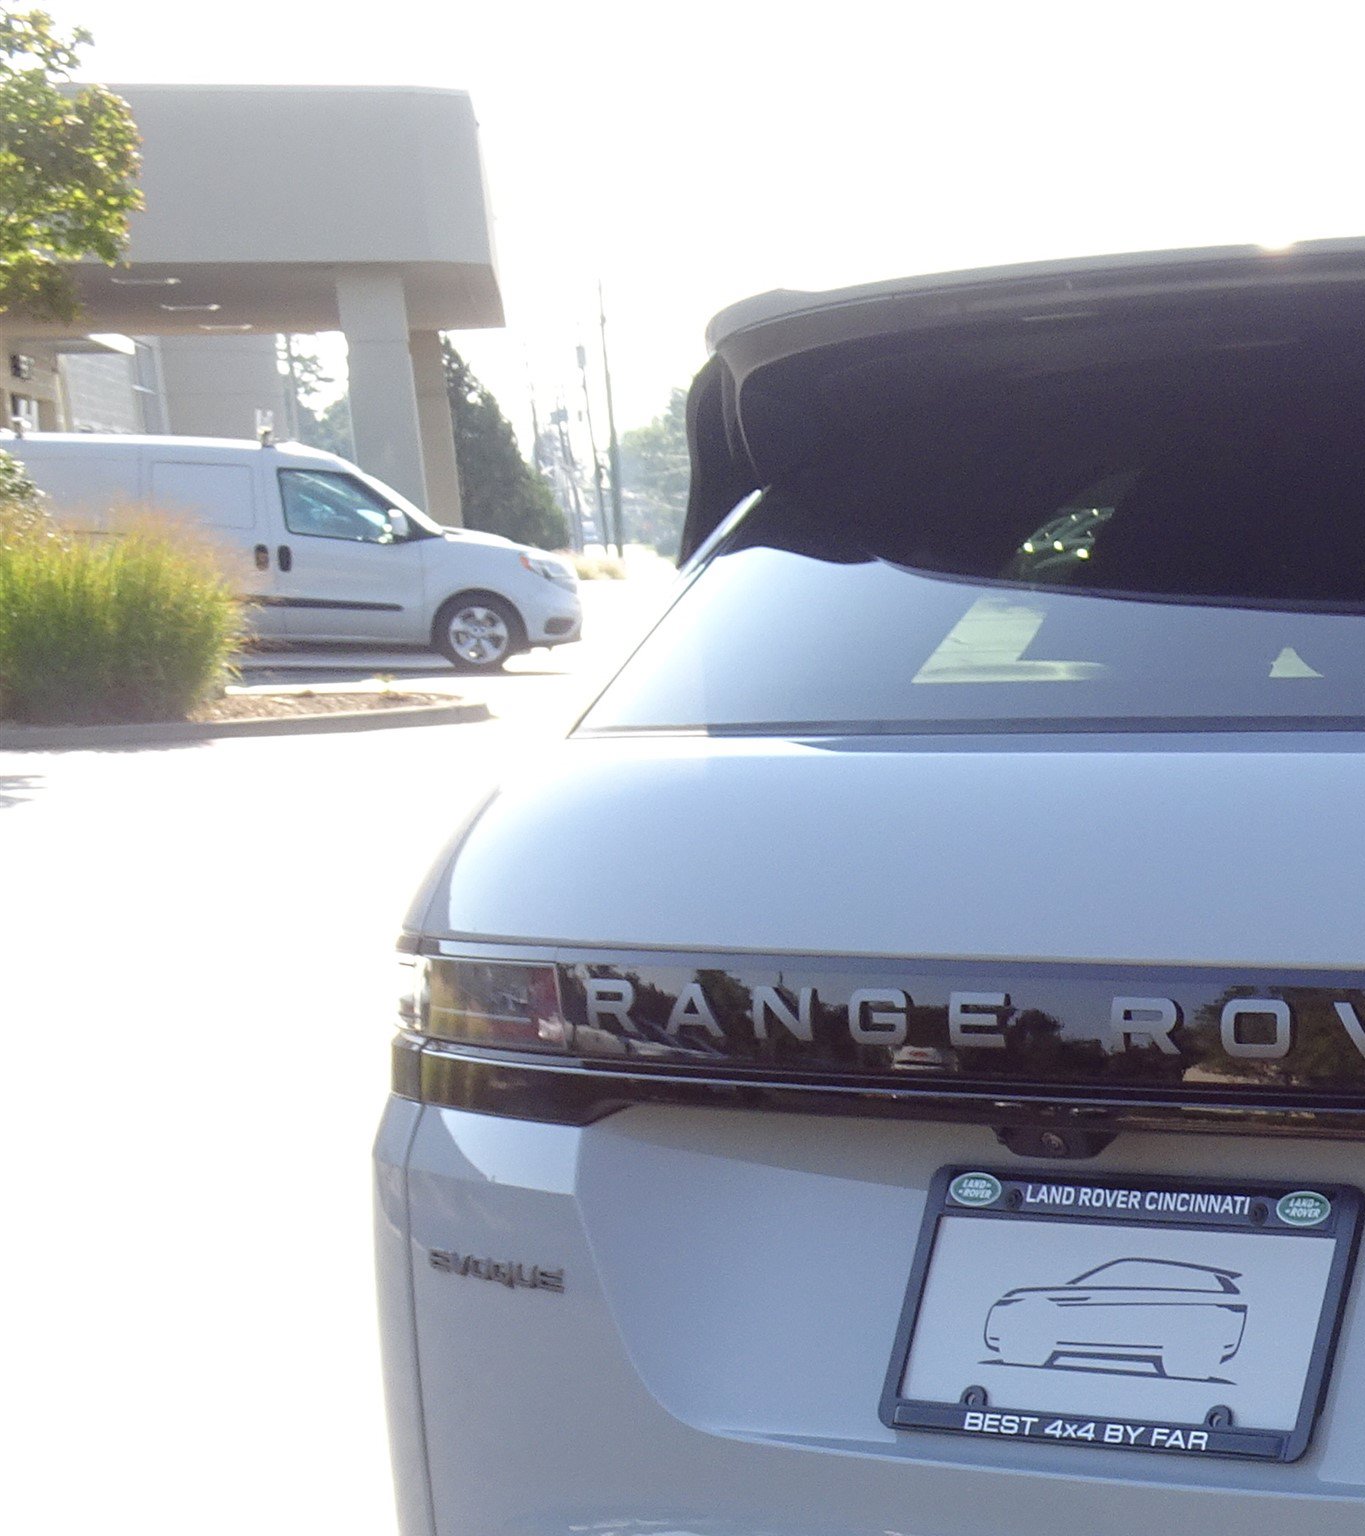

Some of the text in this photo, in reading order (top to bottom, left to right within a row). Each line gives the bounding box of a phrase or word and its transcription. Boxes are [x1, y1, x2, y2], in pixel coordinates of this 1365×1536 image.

[586, 978, 1007, 1049] RANGE
[962, 1179, 987, 1189] LAND
[962, 1188, 993, 1200] ROVER
[1026, 1185, 1251, 1216] LAND ROVER CINCINNATI
[1288, 1198, 1315, 1208] LAND
[963, 1411, 1209, 1451] BEST 4x4 BY FAR
